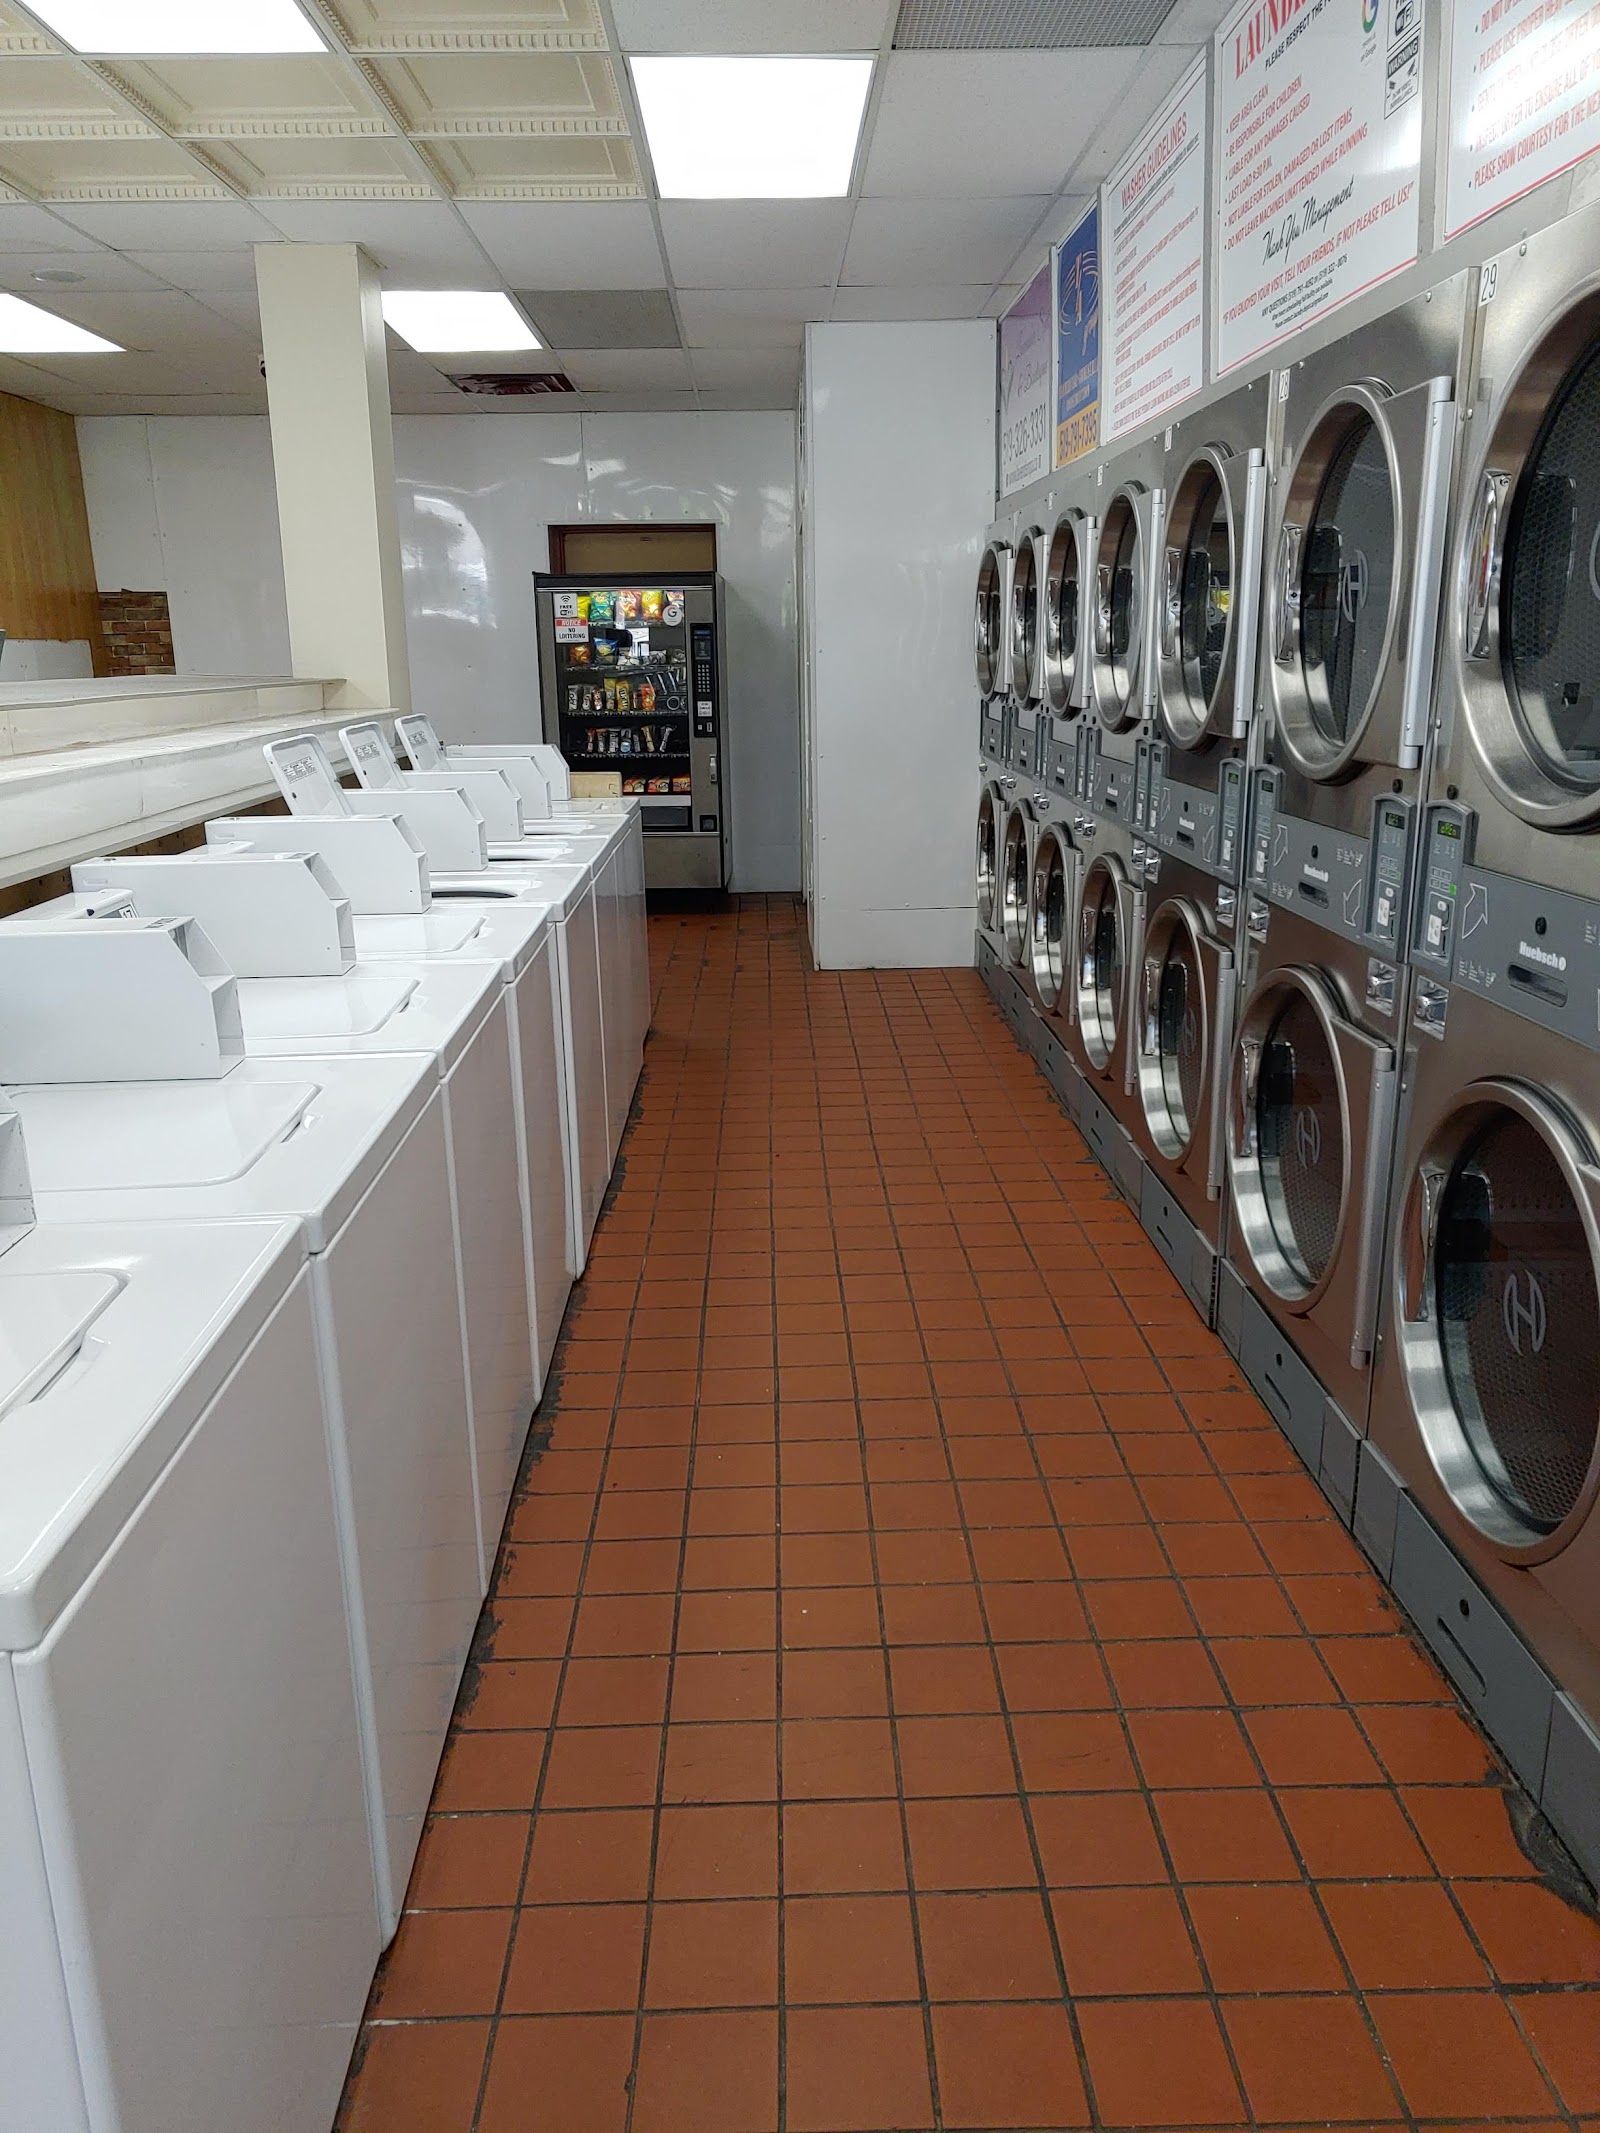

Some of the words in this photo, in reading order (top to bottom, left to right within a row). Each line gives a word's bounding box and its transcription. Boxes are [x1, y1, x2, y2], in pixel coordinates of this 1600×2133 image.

[1265, 40, 1284, 72] PLEASE
[1285, 12, 1309, 50] RESPECT
[1253, 81, 1268, 109] CLEAN
[1265, 100, 1275, 122] FOR
[1289, 90, 1310, 124] CAUSED
[1319, 120, 1334, 150] LOST
[1334, 103, 1352, 136] ITEMS
[1474, 156, 1497, 190] PLEASE
[1497, 143, 1517, 175] SHOW
[1517, 119, 1553, 162] COURTESY
[1554, 109, 1568, 139] FOR
[1570, 98, 1585, 129] THE
[1122, 162, 1146, 210] WASHER
[1148, 111, 1187, 178] GUIDELINES
[1285, 160, 1319, 205] UNATTENDED
[1338, 118, 1367, 160] RUNNING
[1228, 183, 1239, 206] LAST
[1302, 174, 1354, 233] Management
[1356, 204, 1379, 237] PLEASE
[1379, 192, 1396, 221] TELL
[1481, 263, 1497, 302] 29
[558, 632, 586, 640] LOITERING
[1519, 940, 1560, 970] Huebsch
